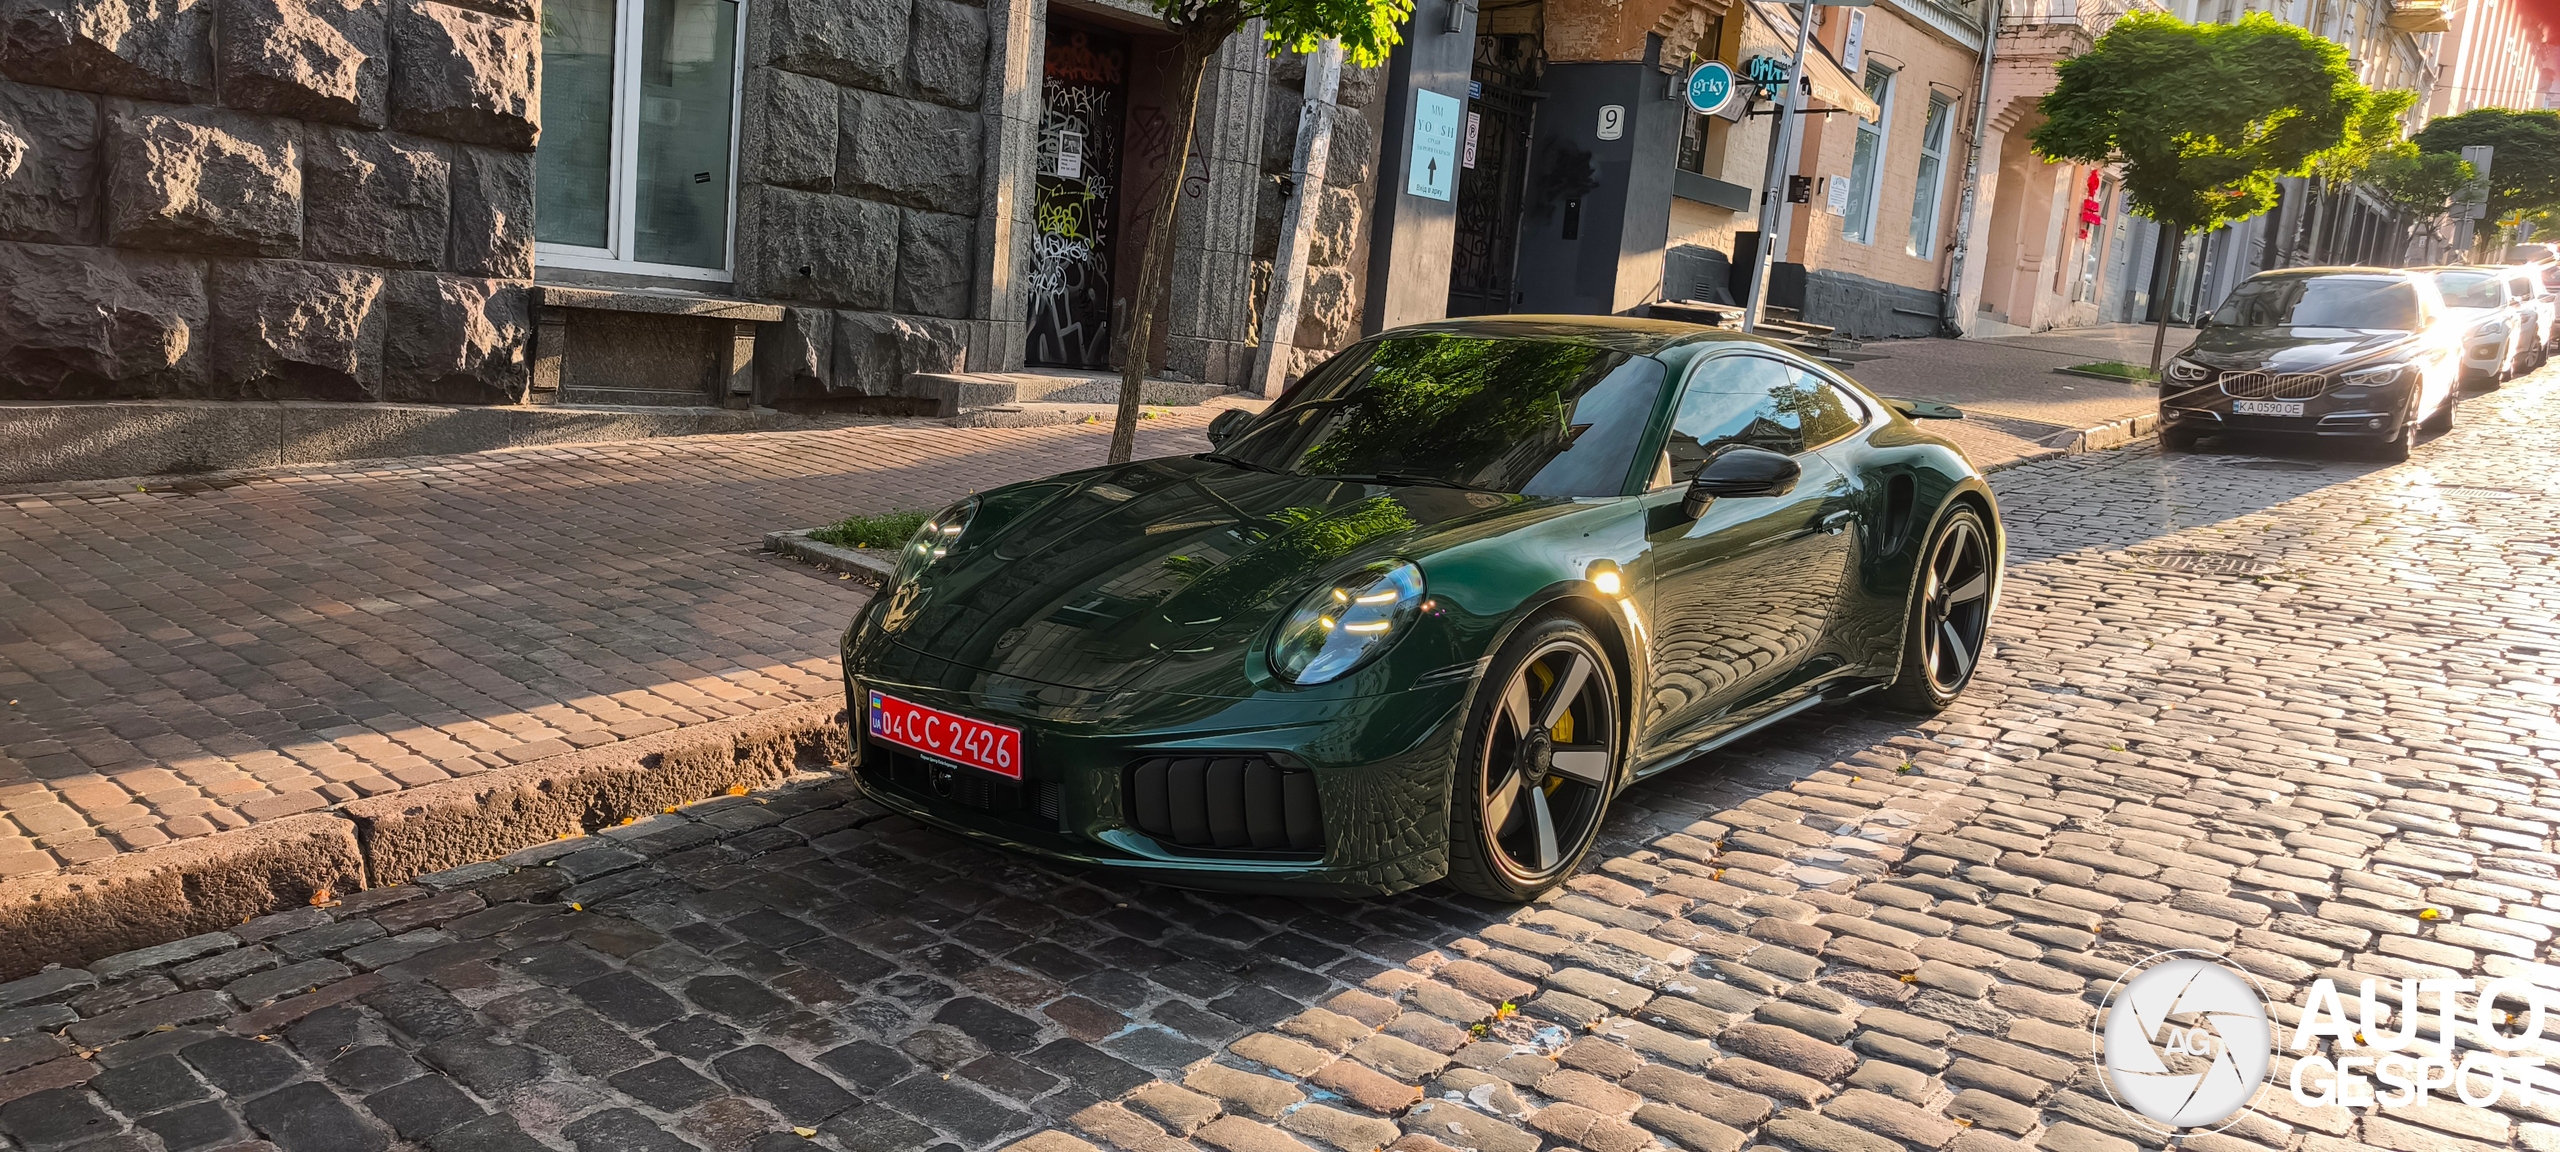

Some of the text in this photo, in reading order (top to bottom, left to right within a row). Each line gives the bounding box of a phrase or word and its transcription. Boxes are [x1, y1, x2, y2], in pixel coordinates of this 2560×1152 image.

[1691, 78, 1726, 97] grky
[1606, 110, 1617, 129] 9
[2240, 402, 2300, 414] KA 0590 OE
[872, 717, 881, 730] UA
[882, 711, 902, 739] 04
[907, 710, 941, 748] CC
[949, 722, 1011, 768] 2426
